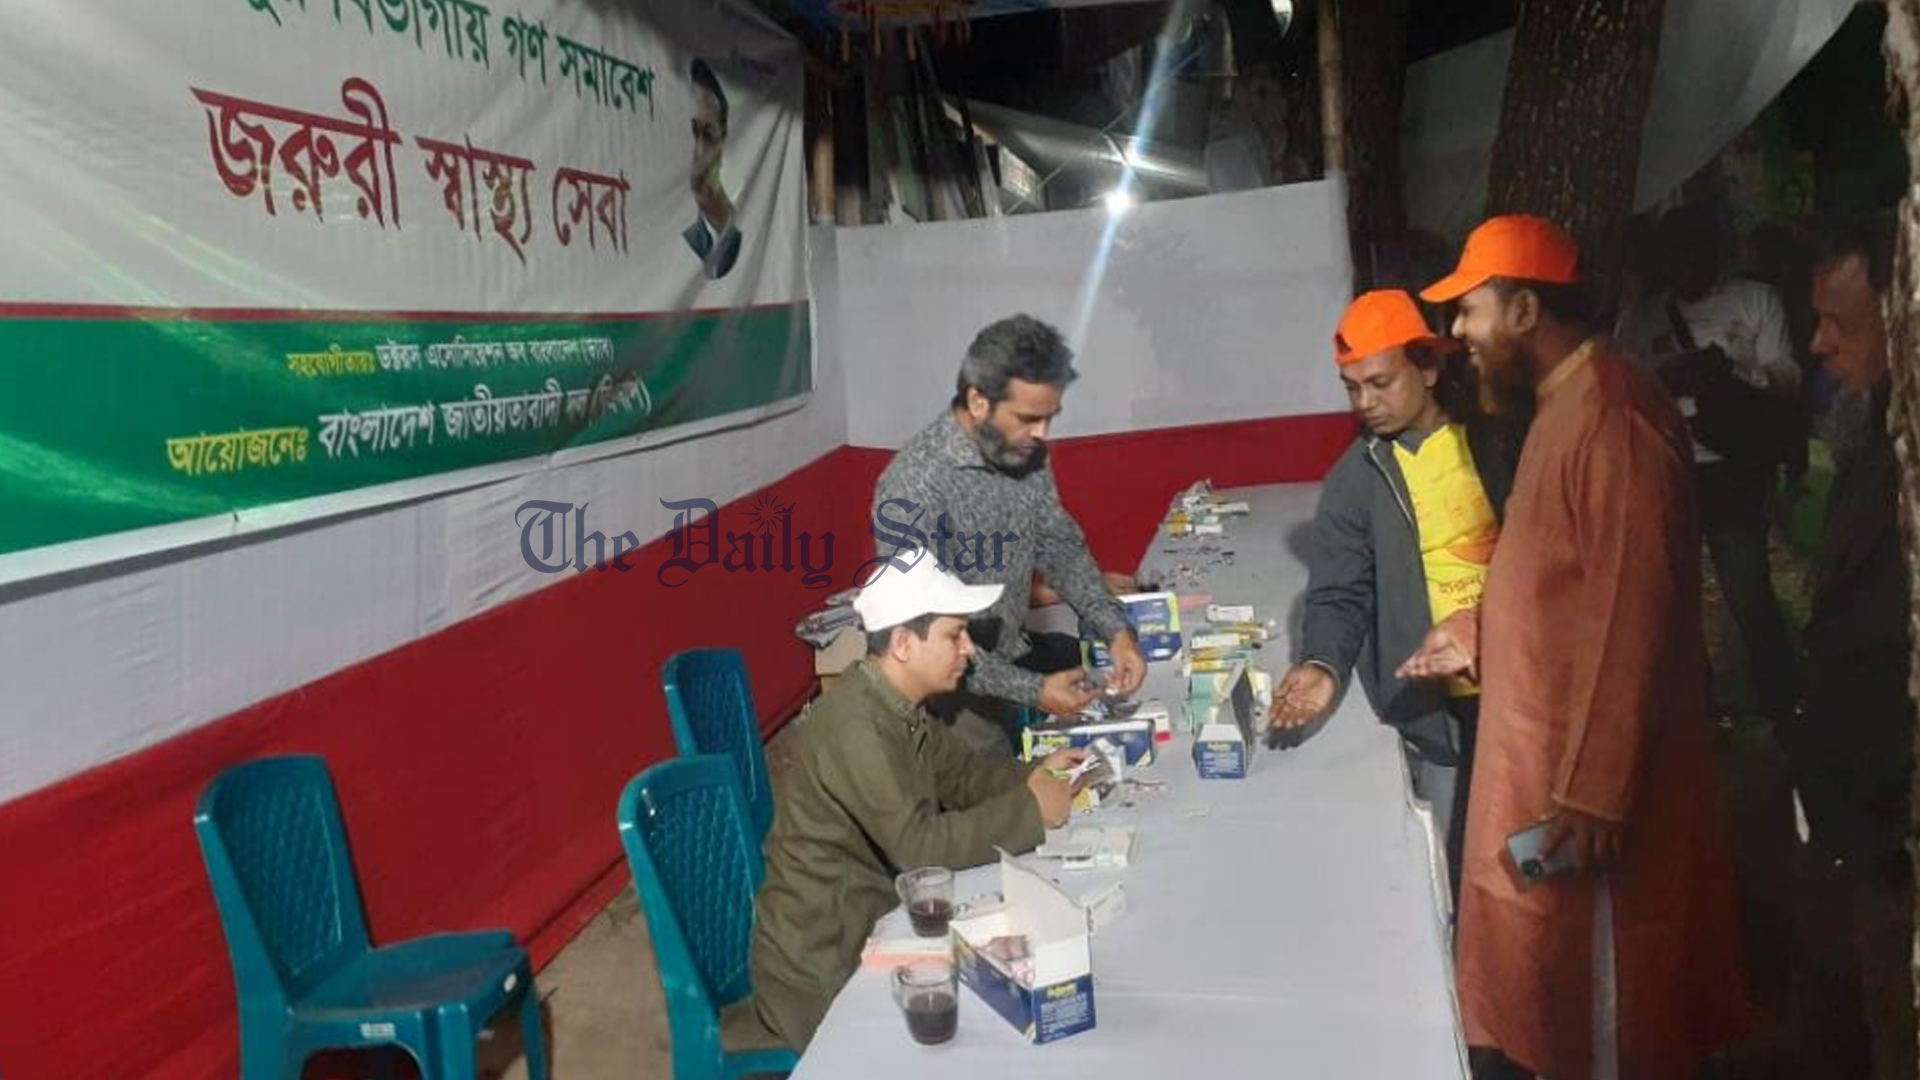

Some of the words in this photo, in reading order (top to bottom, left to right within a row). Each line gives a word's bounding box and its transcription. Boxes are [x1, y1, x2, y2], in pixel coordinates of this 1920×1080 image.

[502, 16, 547, 82] গণ
[556, 35, 655, 121] সমাবেশ
[189, 77, 403, 231] জরুরী
[415, 133, 536, 266] স্বাস্থ্য
[553, 166, 631, 256] সেবা
[318, 401, 436, 458] বাংলাদেশ
[440, 384, 563, 440] জাতীয়তাবাদী
